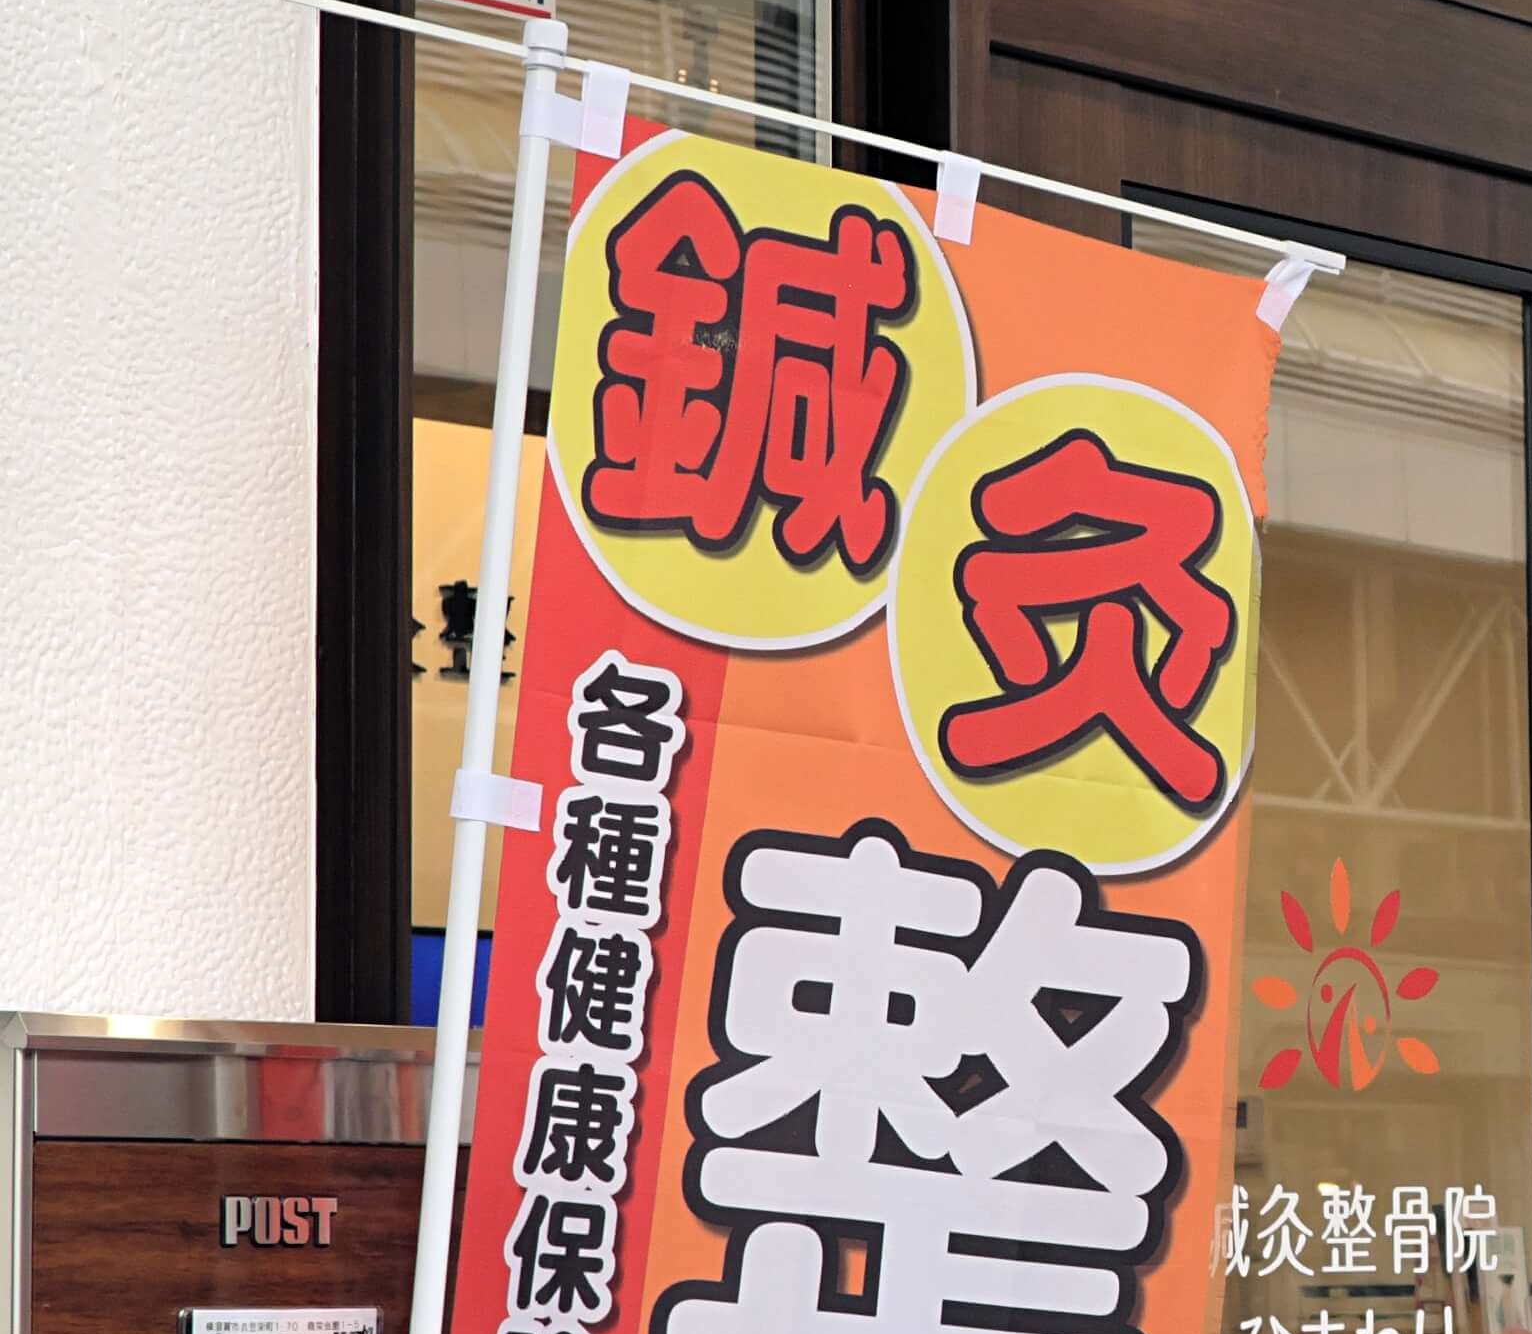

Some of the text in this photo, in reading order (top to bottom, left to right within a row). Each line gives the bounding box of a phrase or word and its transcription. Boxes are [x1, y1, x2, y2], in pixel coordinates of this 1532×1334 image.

[582, 169, 918, 575] 鍼
[938, 427, 1238, 807] 灸
[220, 1195, 338, 1247] POST
